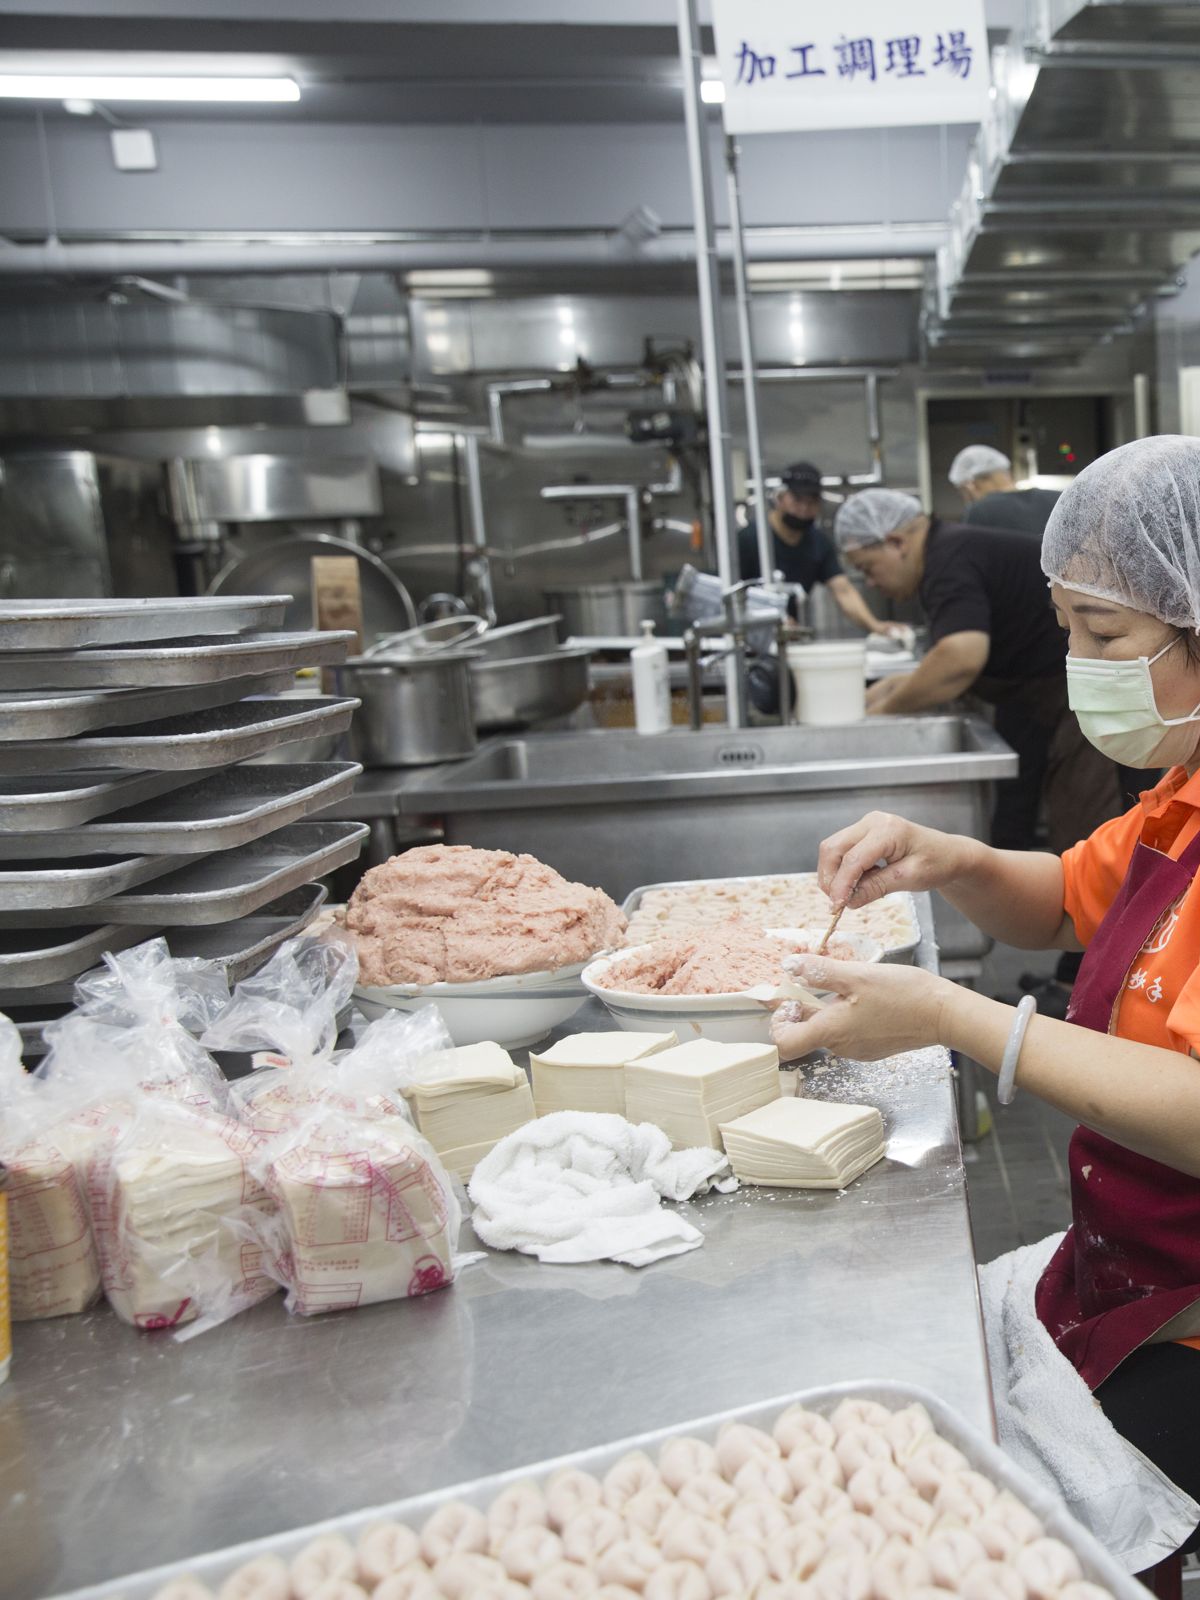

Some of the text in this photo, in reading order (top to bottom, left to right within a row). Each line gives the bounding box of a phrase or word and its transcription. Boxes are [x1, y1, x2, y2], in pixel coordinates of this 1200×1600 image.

[735, 31, 973, 85] 加工調理場
